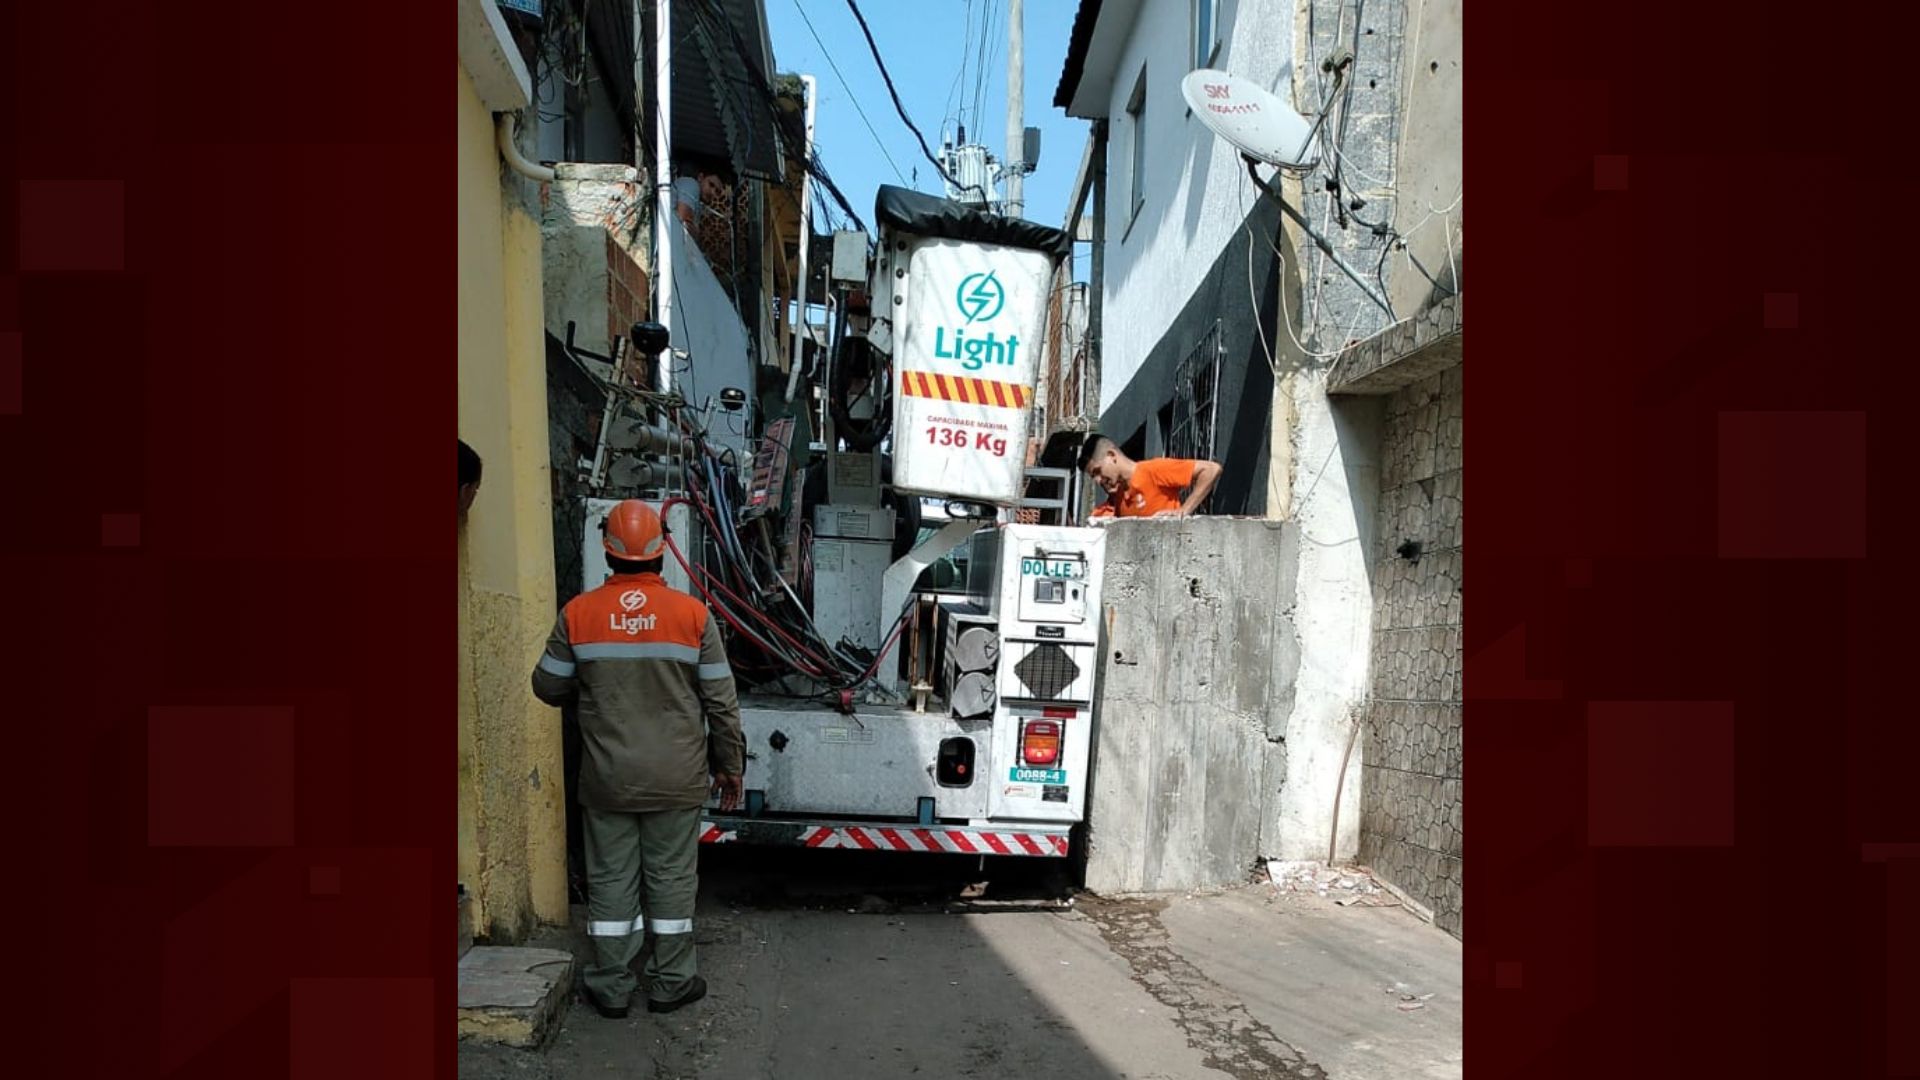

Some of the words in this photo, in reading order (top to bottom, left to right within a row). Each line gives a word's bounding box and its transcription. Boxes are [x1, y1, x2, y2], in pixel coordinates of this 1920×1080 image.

[1204, 84, 1230, 99] SKY
[935, 327, 1019, 370] Light
[926, 427, 967, 448] 136
[975, 432, 1007, 457] Kg
[610, 613, 656, 635] Light
